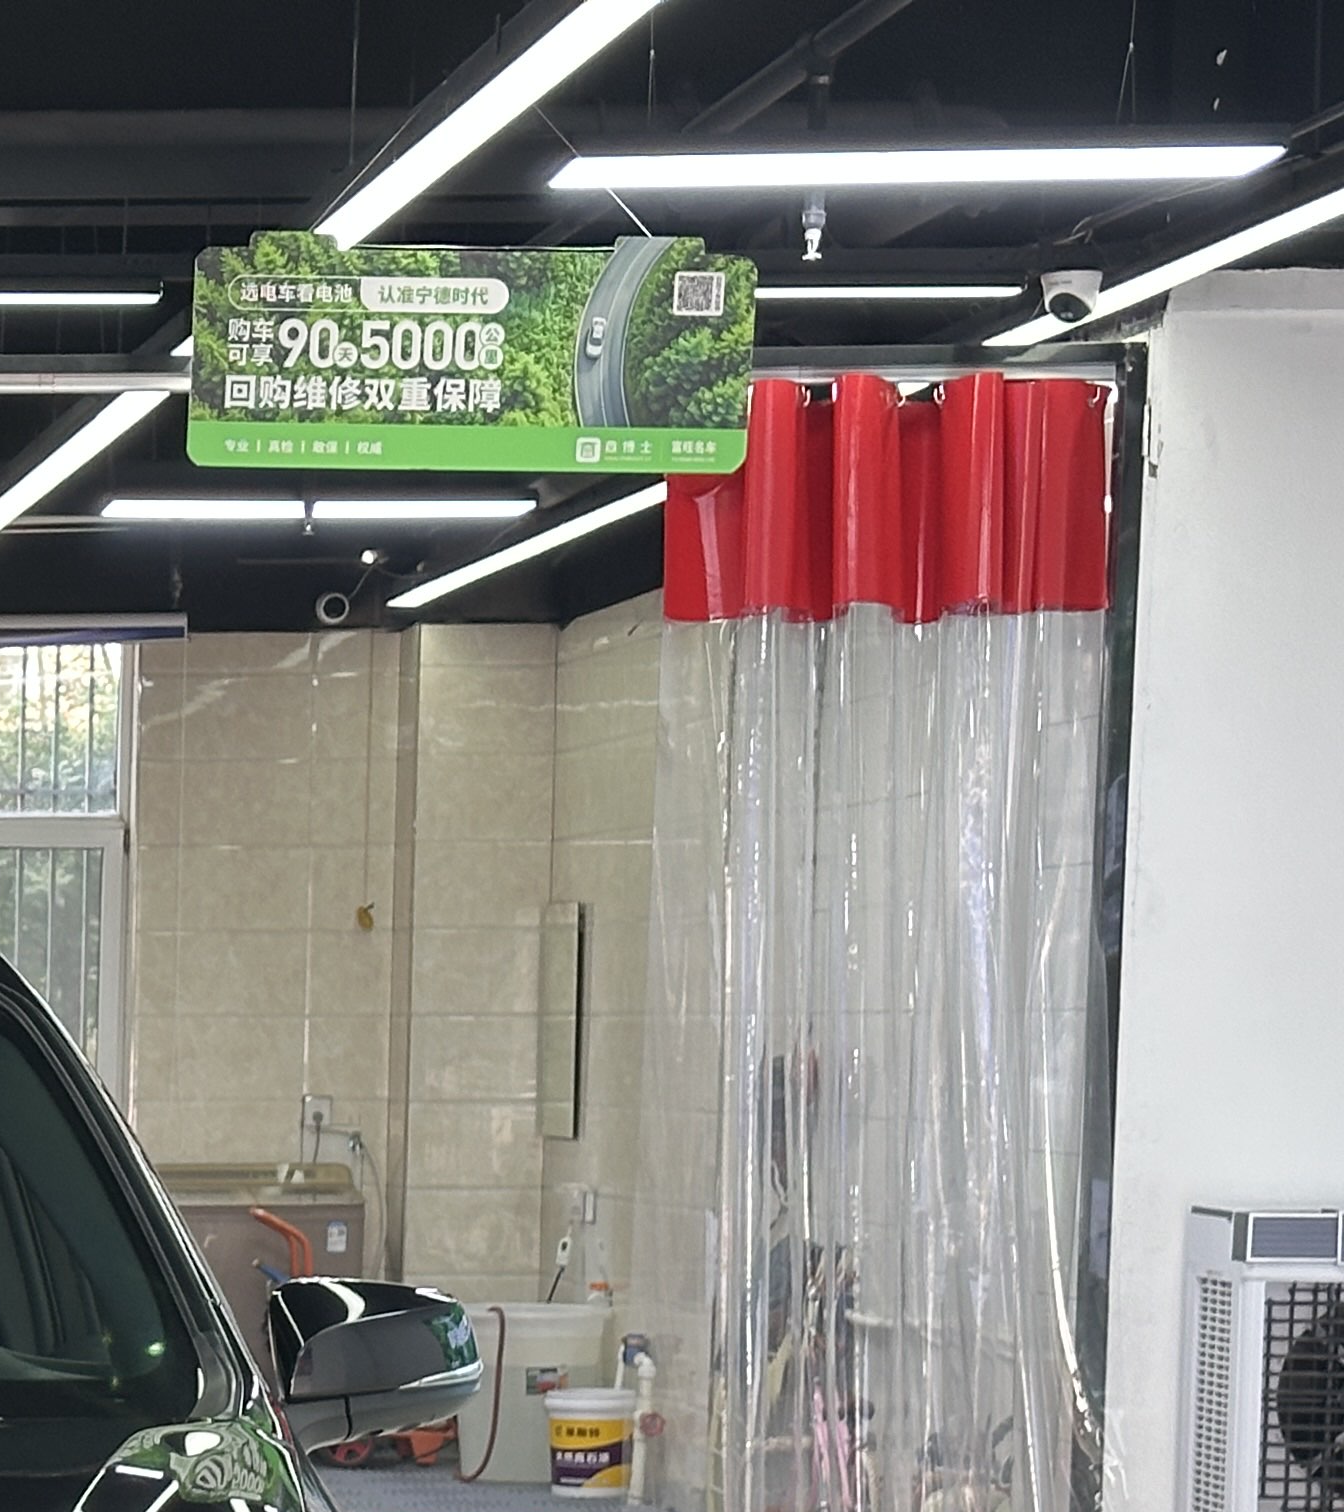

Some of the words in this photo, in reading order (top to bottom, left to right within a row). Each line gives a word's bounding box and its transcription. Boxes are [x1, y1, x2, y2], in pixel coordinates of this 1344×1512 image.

[239, 281, 353, 304] 选电车看电池
[377, 284, 490, 306] 认准宁德时代
[227, 318, 274, 343] 购车
[227, 344, 274, 367] 可享
[223, 374, 502, 413] 回购维修双重保障
